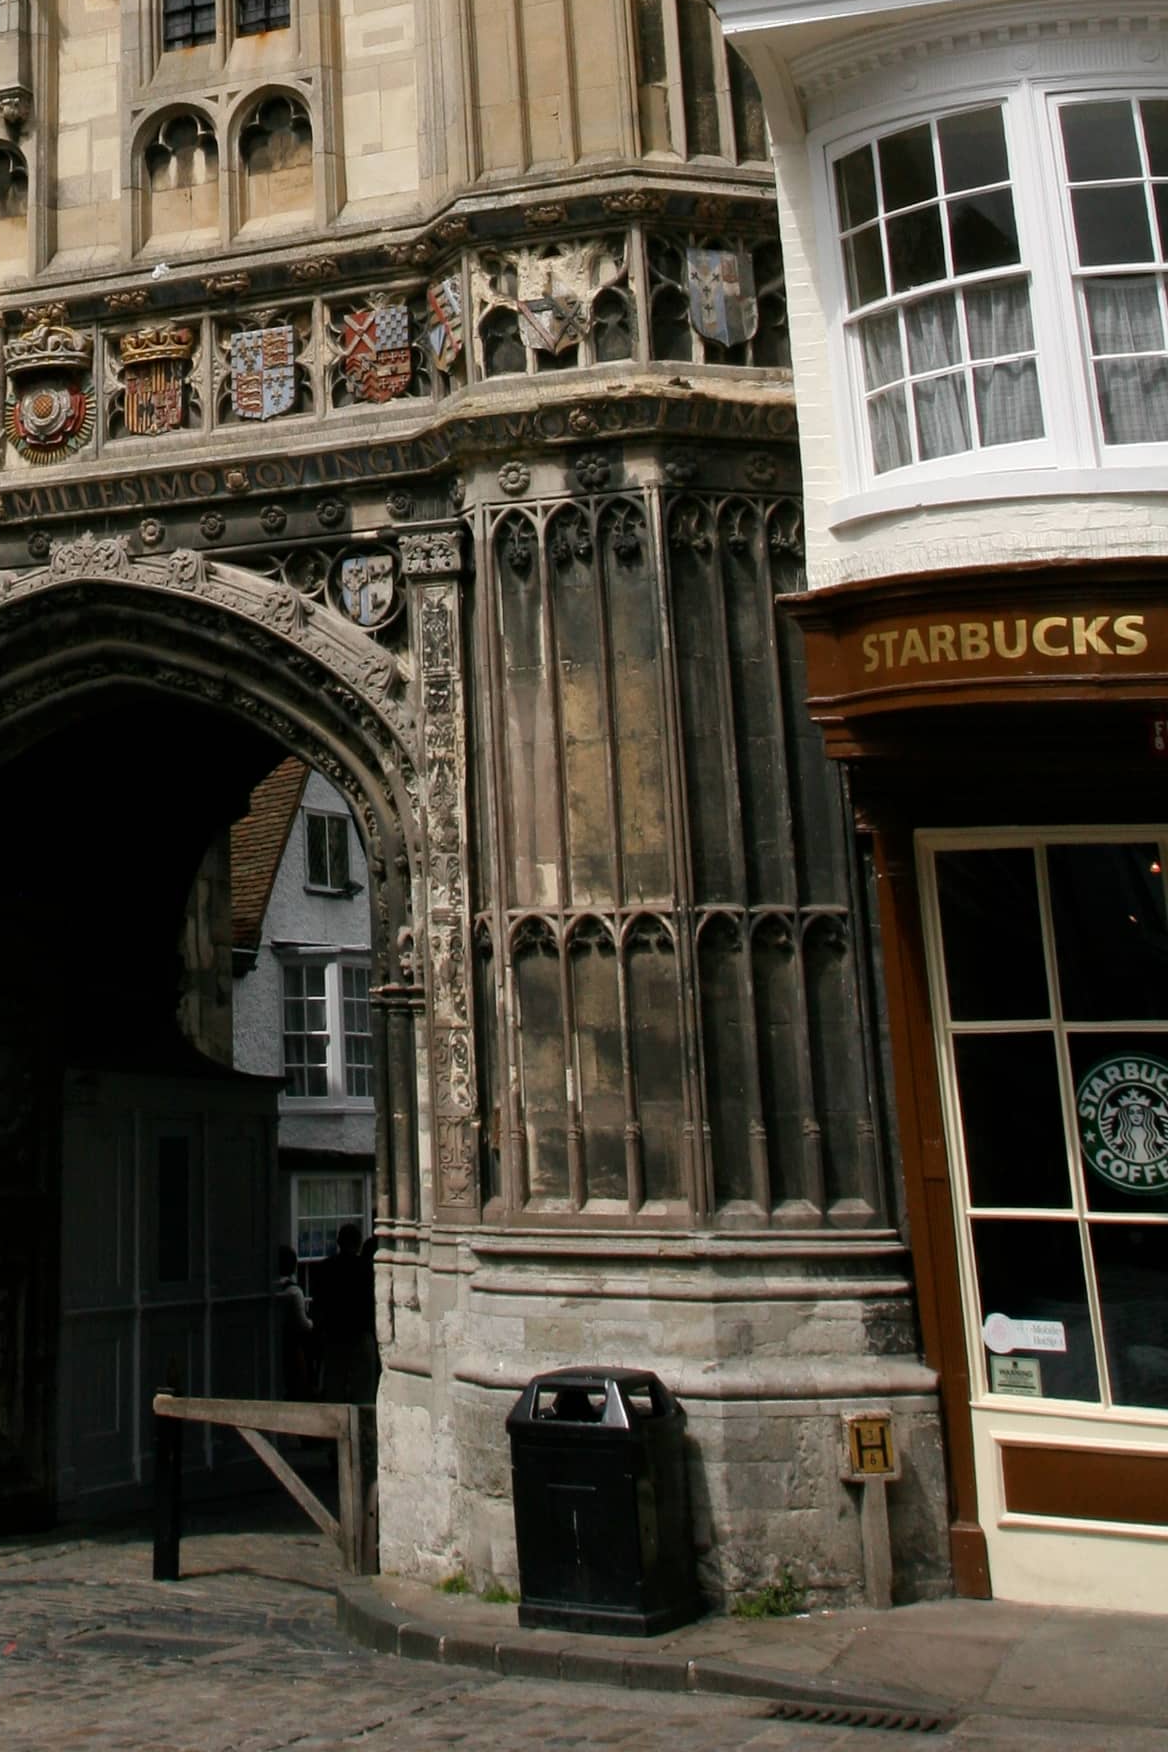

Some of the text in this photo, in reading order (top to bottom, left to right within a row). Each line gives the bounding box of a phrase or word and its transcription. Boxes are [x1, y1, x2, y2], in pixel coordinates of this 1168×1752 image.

[12, 469, 218, 517] MILLESIMO
[862, 614, 1148, 673] STARBUCKS
[855, 1426, 890, 1469] H
